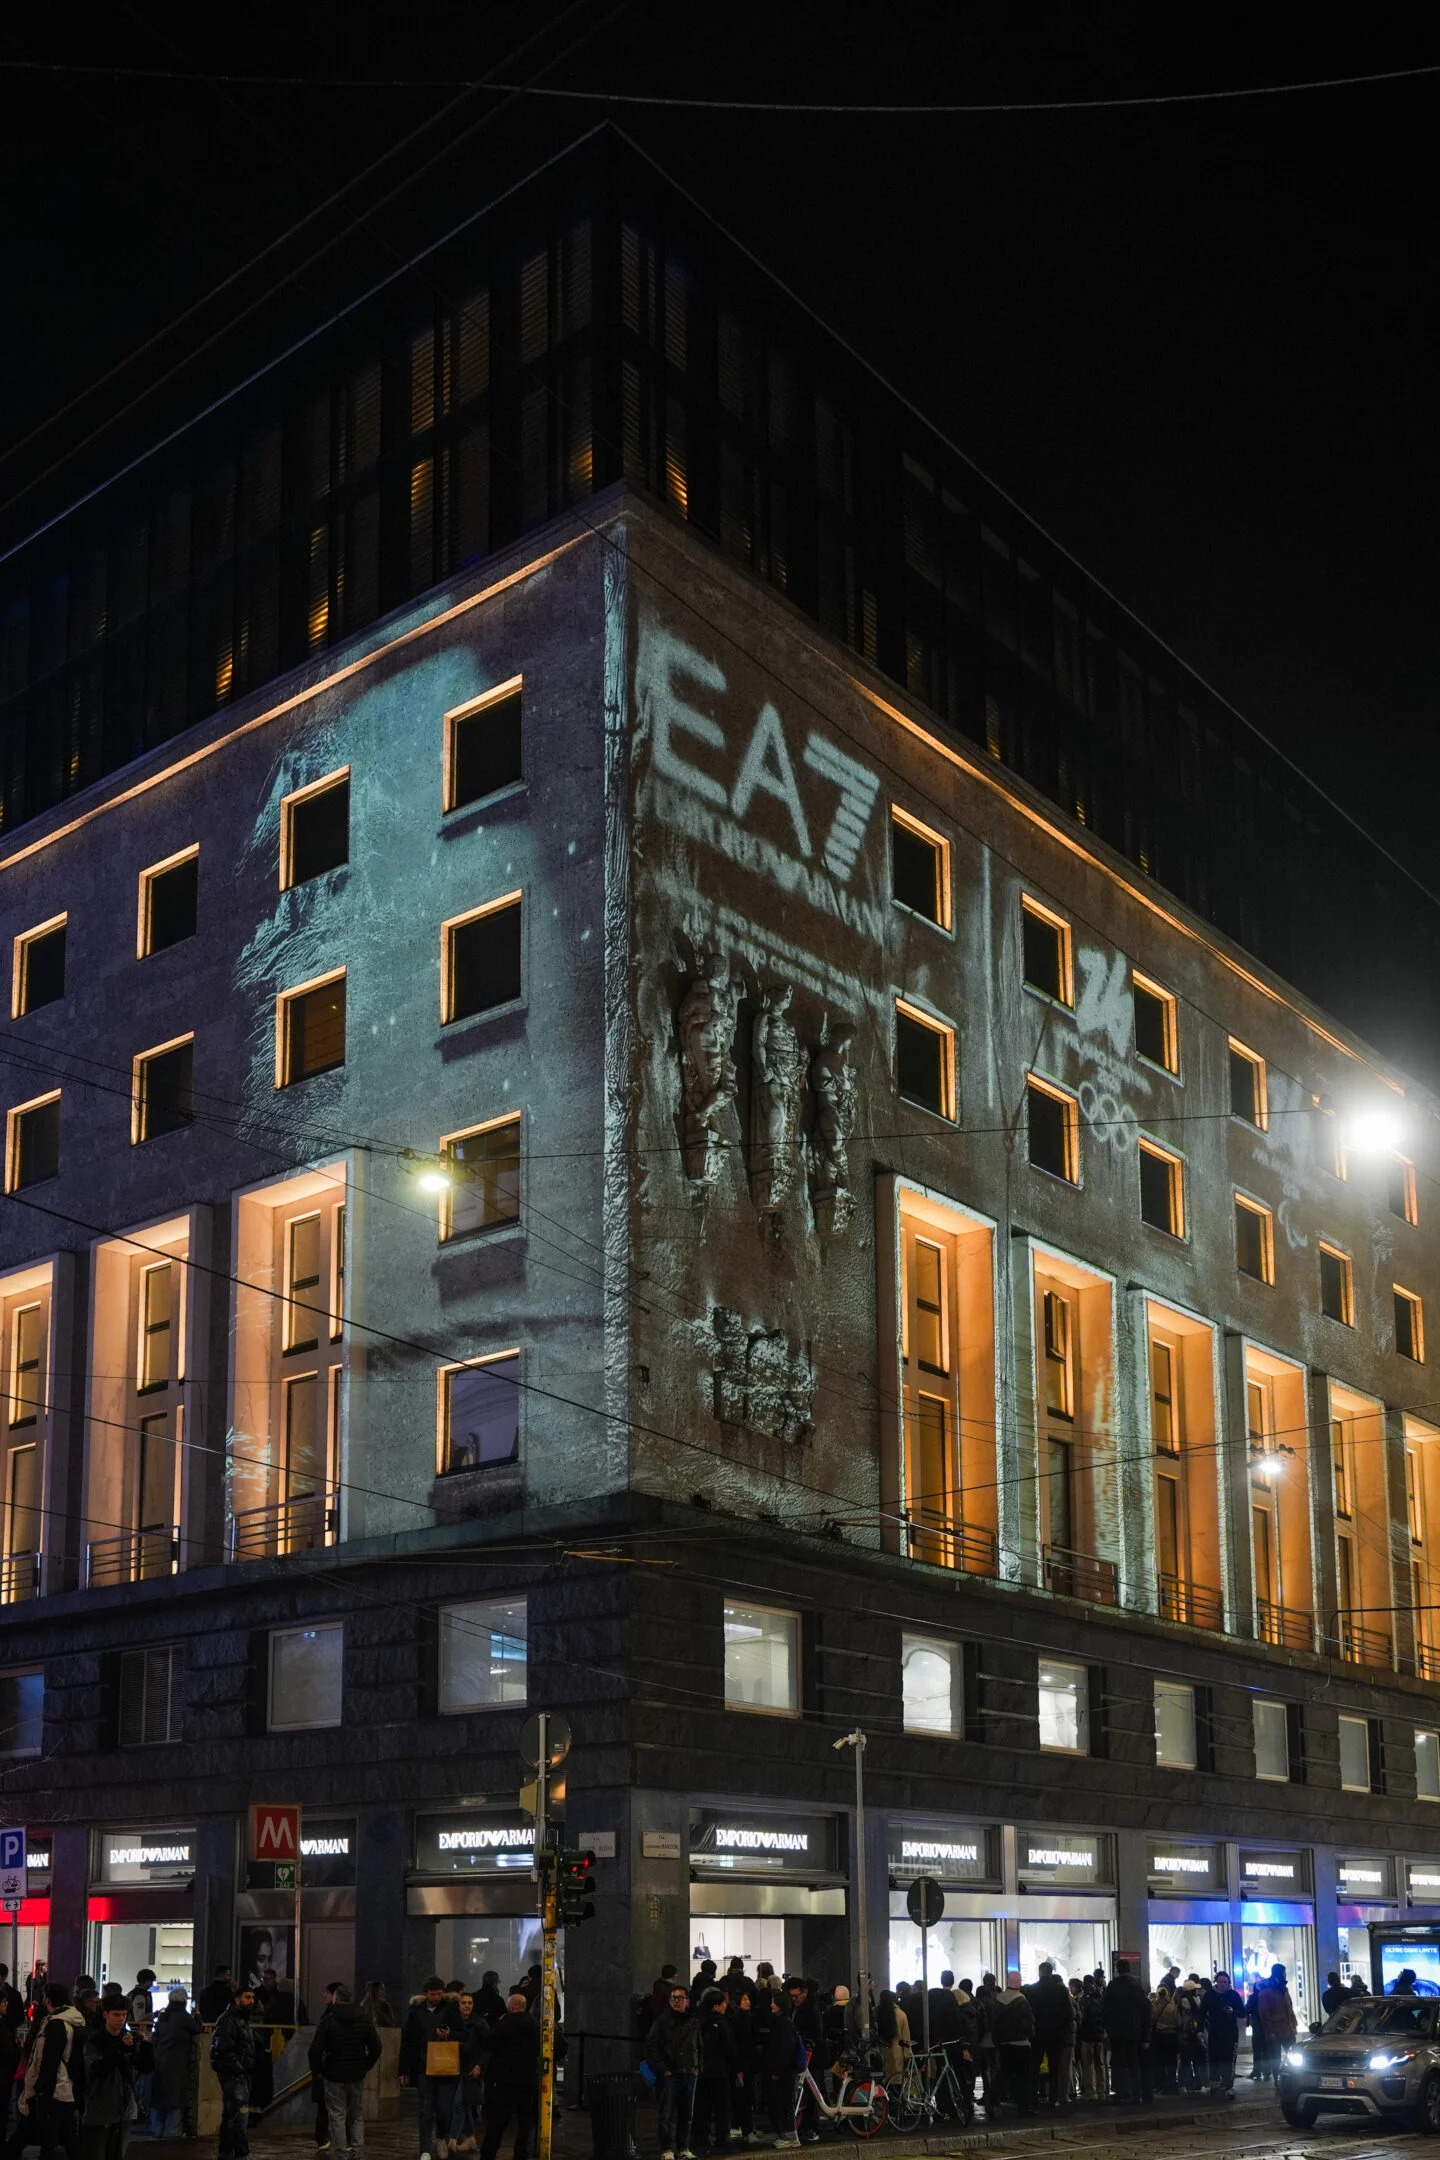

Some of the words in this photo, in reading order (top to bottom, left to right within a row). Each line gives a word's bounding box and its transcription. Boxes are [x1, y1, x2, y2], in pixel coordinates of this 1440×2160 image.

[638, 625, 880, 882] EA7
[259, 1816, 294, 1848] M
[439, 1831, 489, 1849] EMPORIO
[500, 1828, 536, 1846] ARMA
[716, 1829, 760, 1848] EMPORIO
[772, 1833, 808, 1850] ARMANI
[5, 1836, 19, 1865] P
[110, 1848, 147, 1864] EMPORIO
[156, 1846, 189, 1862] ARMANI
[311, 1838, 349, 1854] ARMANI
[902, 1841, 937, 1858] EMPORIO
[947, 1844, 977, 1860] ARMANI
[27, 1853, 49, 1868] RMANI
[1028, 1849, 1058, 1864] EMPORIO
[1067, 1851, 1092, 1866] ARMANI
